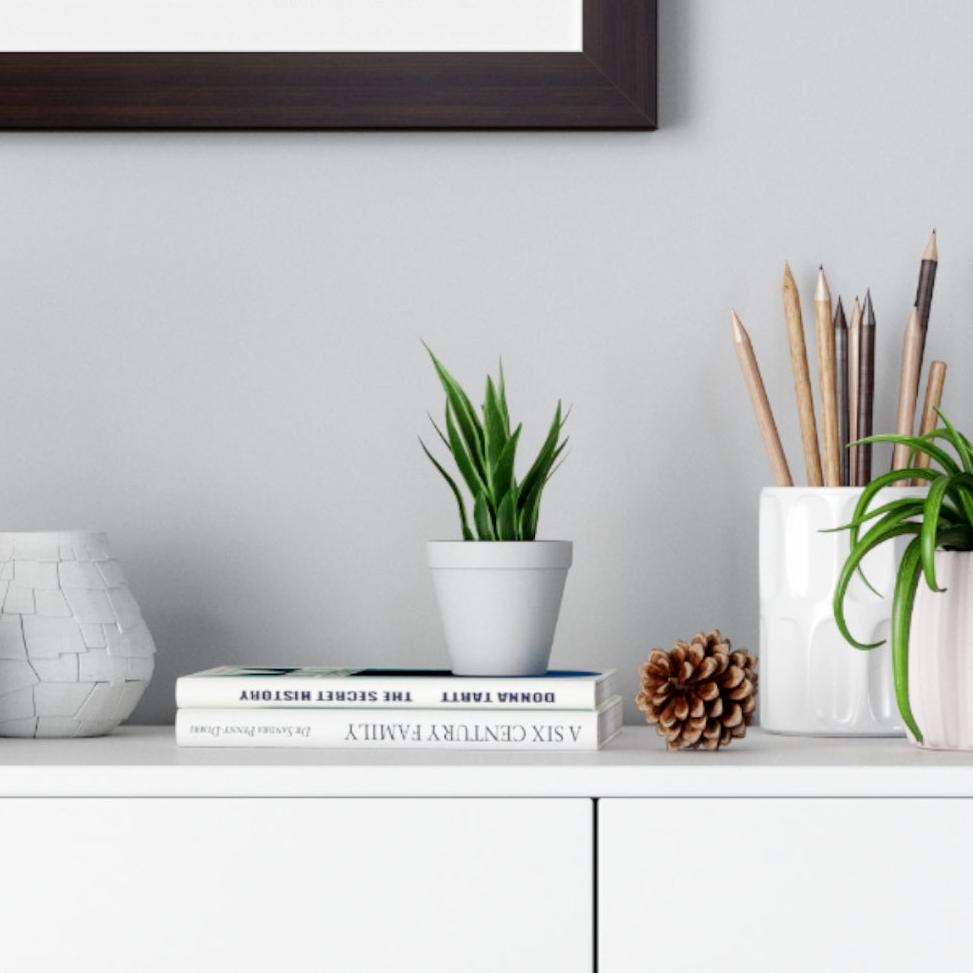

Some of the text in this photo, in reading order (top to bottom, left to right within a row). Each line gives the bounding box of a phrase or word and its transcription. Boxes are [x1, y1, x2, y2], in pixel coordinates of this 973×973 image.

[239, 690, 413, 702] THE SECRET HISTORY
[440, 691, 556, 703] DONNA TARTT
[344, 723, 582, 743] A SIX CENTURY FAMILY
